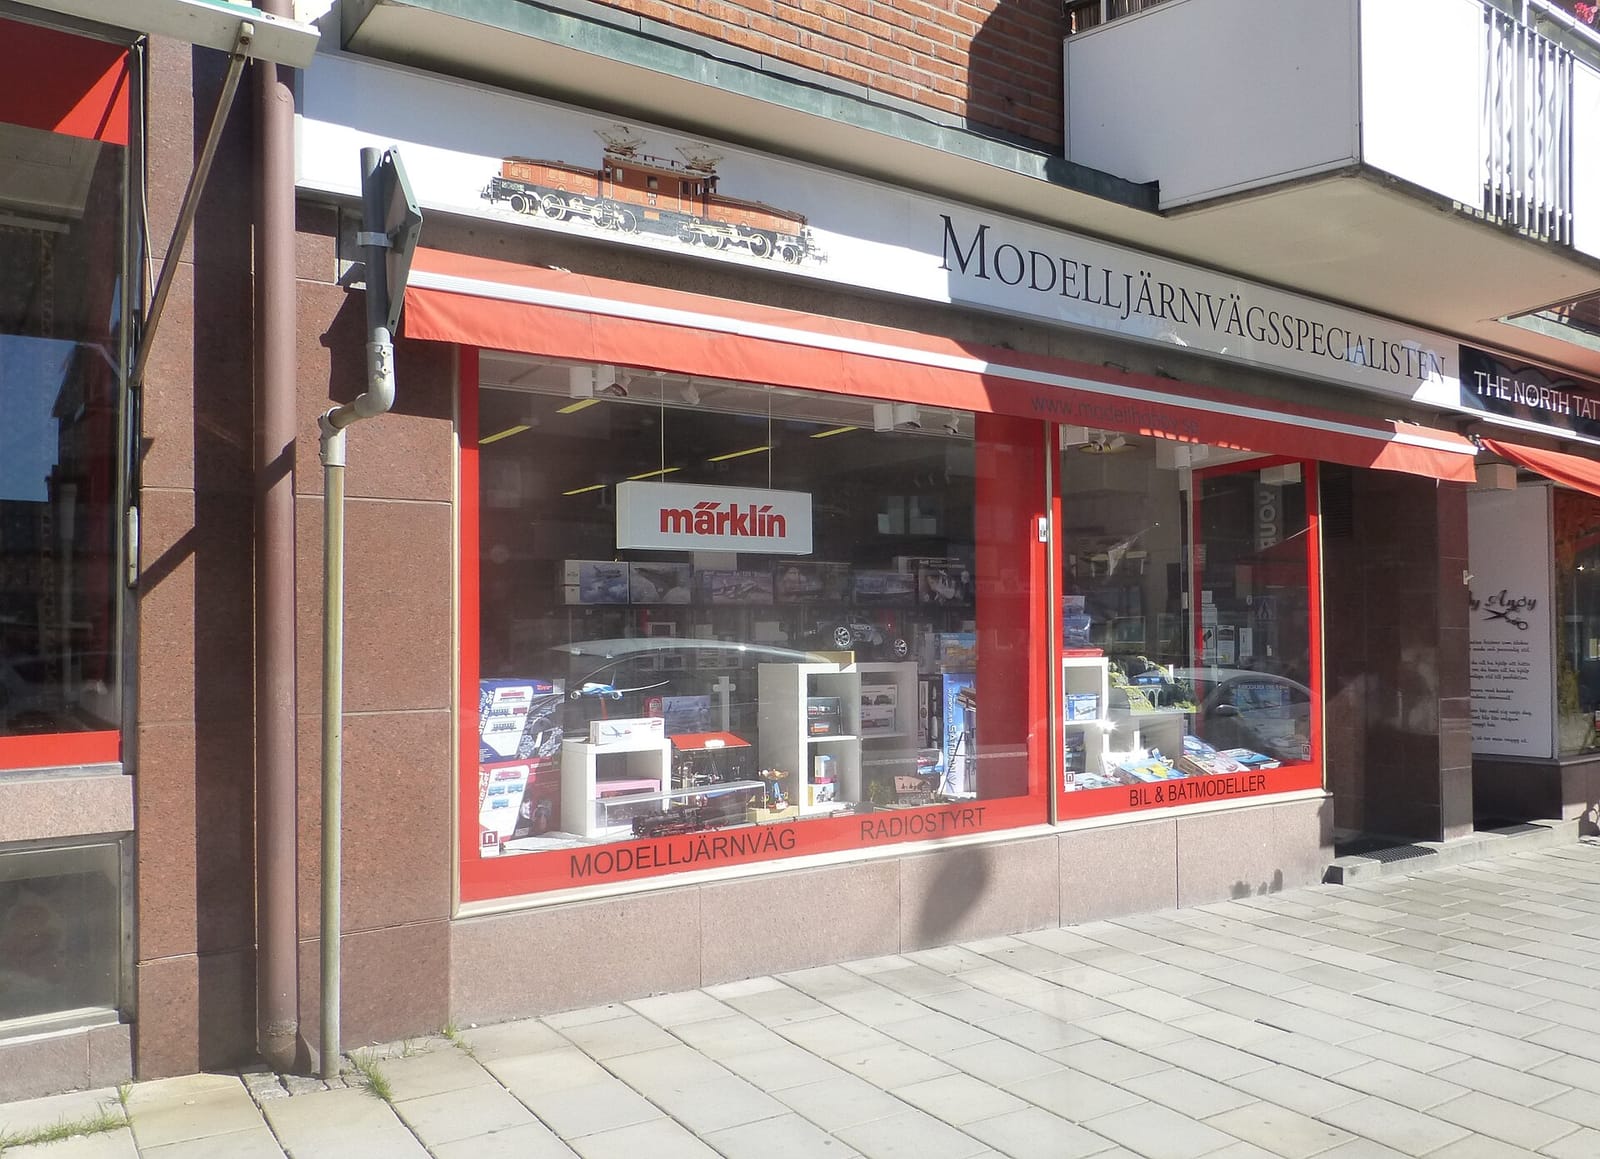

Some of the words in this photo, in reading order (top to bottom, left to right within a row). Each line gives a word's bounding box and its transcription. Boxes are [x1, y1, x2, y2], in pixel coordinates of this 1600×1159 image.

[1474, 370, 1511, 401] THE
[1513, 380, 1570, 415] NORTH
[1031, 397, 1199, 435] www.modellhobby.se
[659, 501, 787, 538] märklin
[1129, 786, 1152, 807] BIL
[1155, 784, 1165, 803] &
[1168, 775, 1266, 800] BÅTMODELLER
[860, 806, 986, 841] RADIOSTYRT
[570, 828, 796, 879] MODELLJÄRNVÄG
